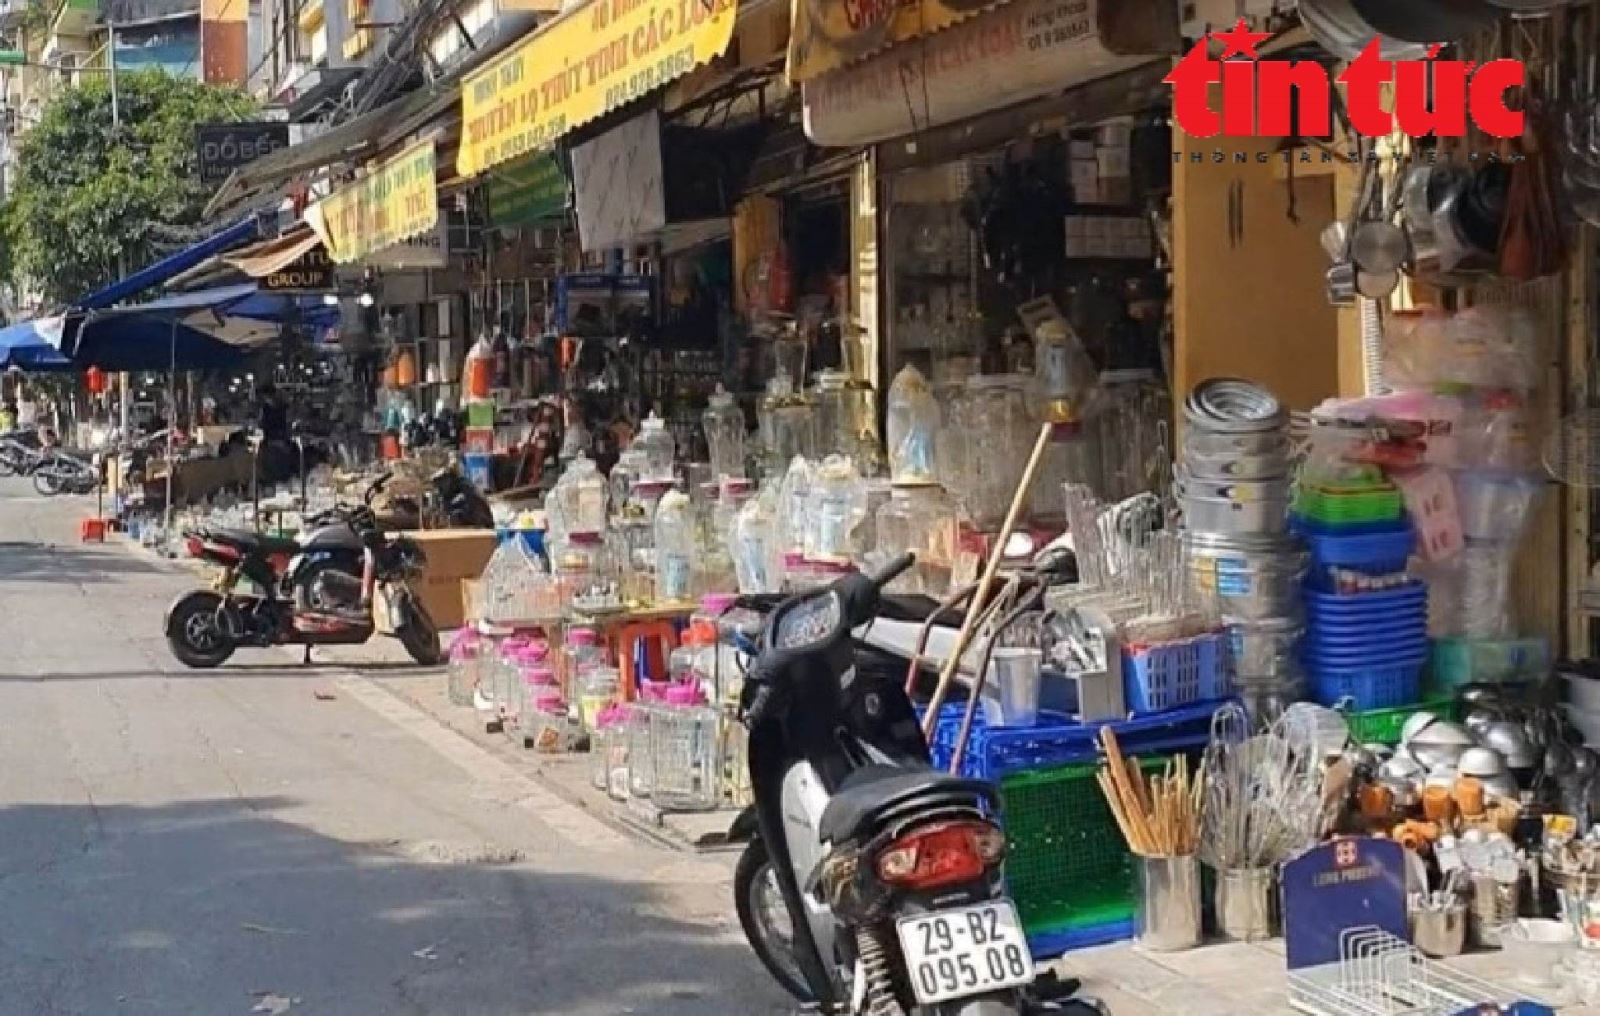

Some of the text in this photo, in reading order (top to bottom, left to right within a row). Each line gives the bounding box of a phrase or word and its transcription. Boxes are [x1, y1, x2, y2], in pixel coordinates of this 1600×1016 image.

[633, 7, 673, 59] CÁC
[267, 271, 324, 288] GROUP
[918, 907, 1004, 957] 29-B2
[918, 943, 1025, 996] 095.08
